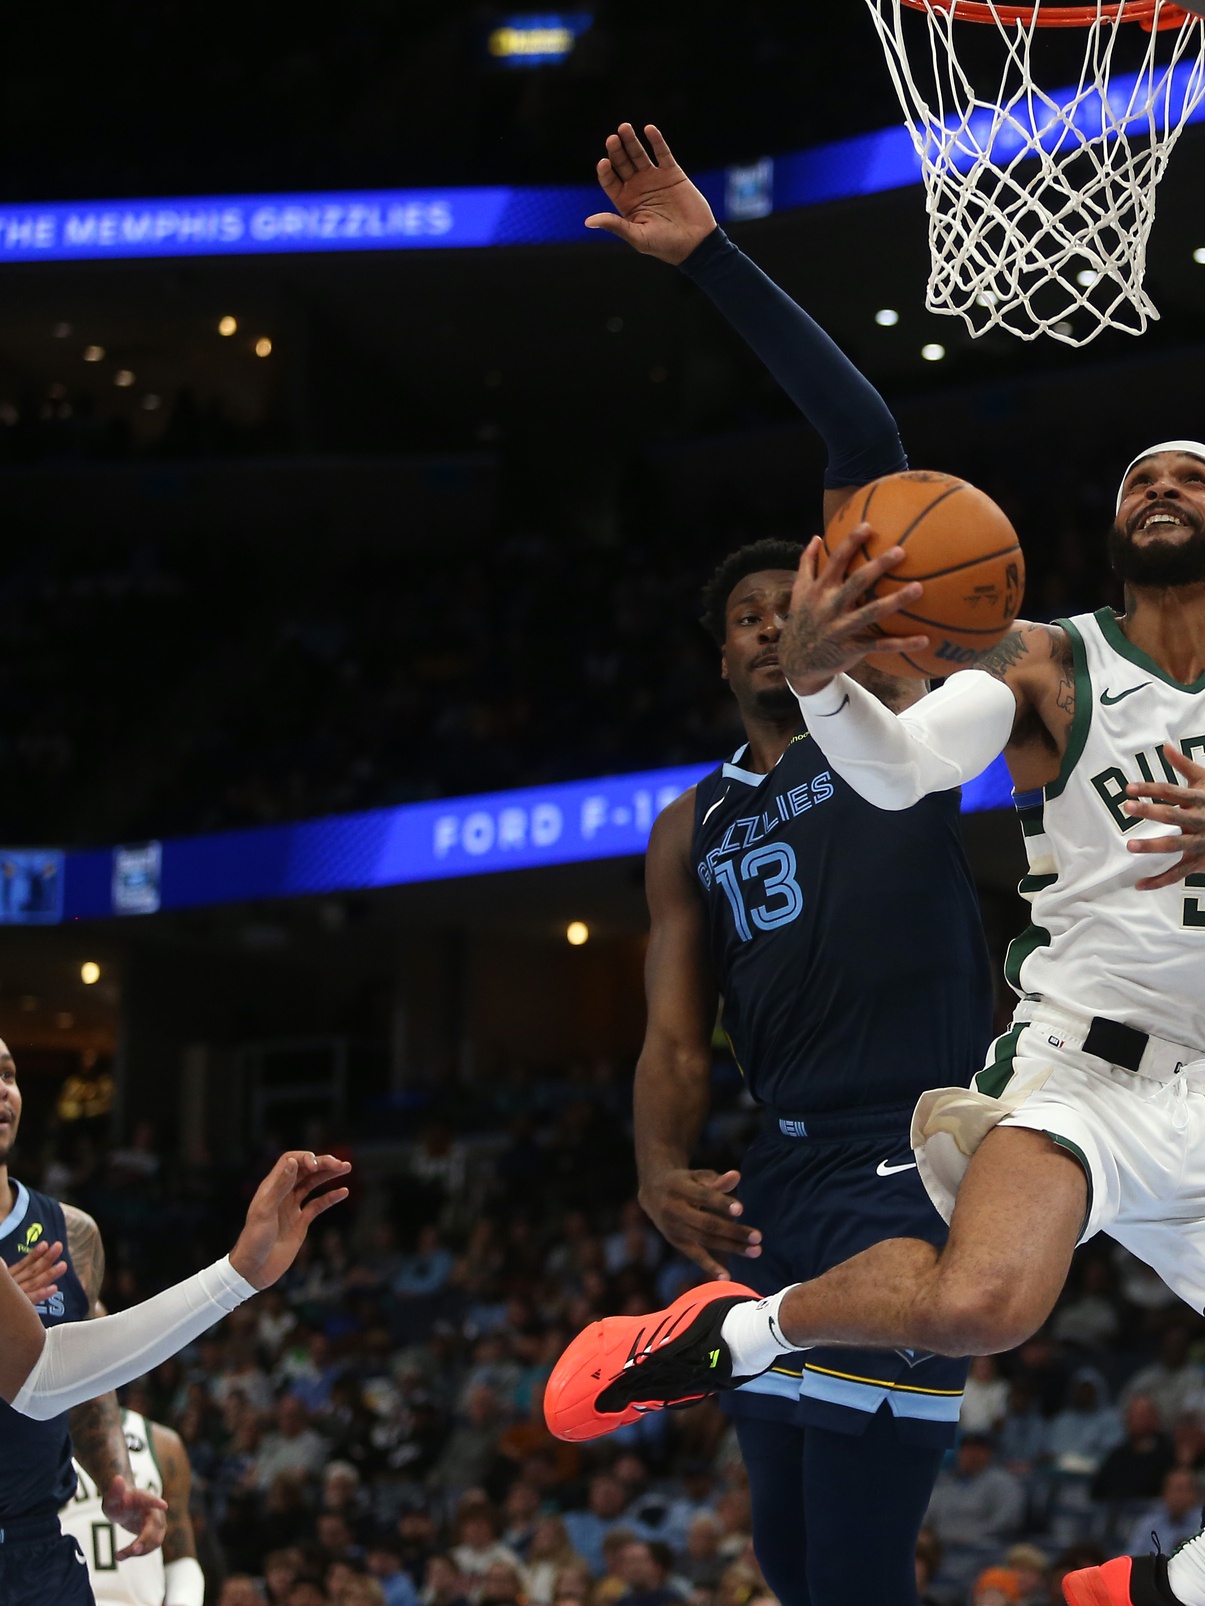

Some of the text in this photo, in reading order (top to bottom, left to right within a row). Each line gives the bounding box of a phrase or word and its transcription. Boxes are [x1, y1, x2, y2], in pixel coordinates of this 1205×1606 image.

[0, 200, 453, 249] HE MEMPHIS GRIZZLIES
[433, 802, 564, 860] FORD
[697, 771, 836, 892] GZZLIES
[711, 841, 804, 943] 13
[91, 1521, 118, 1572] 0
